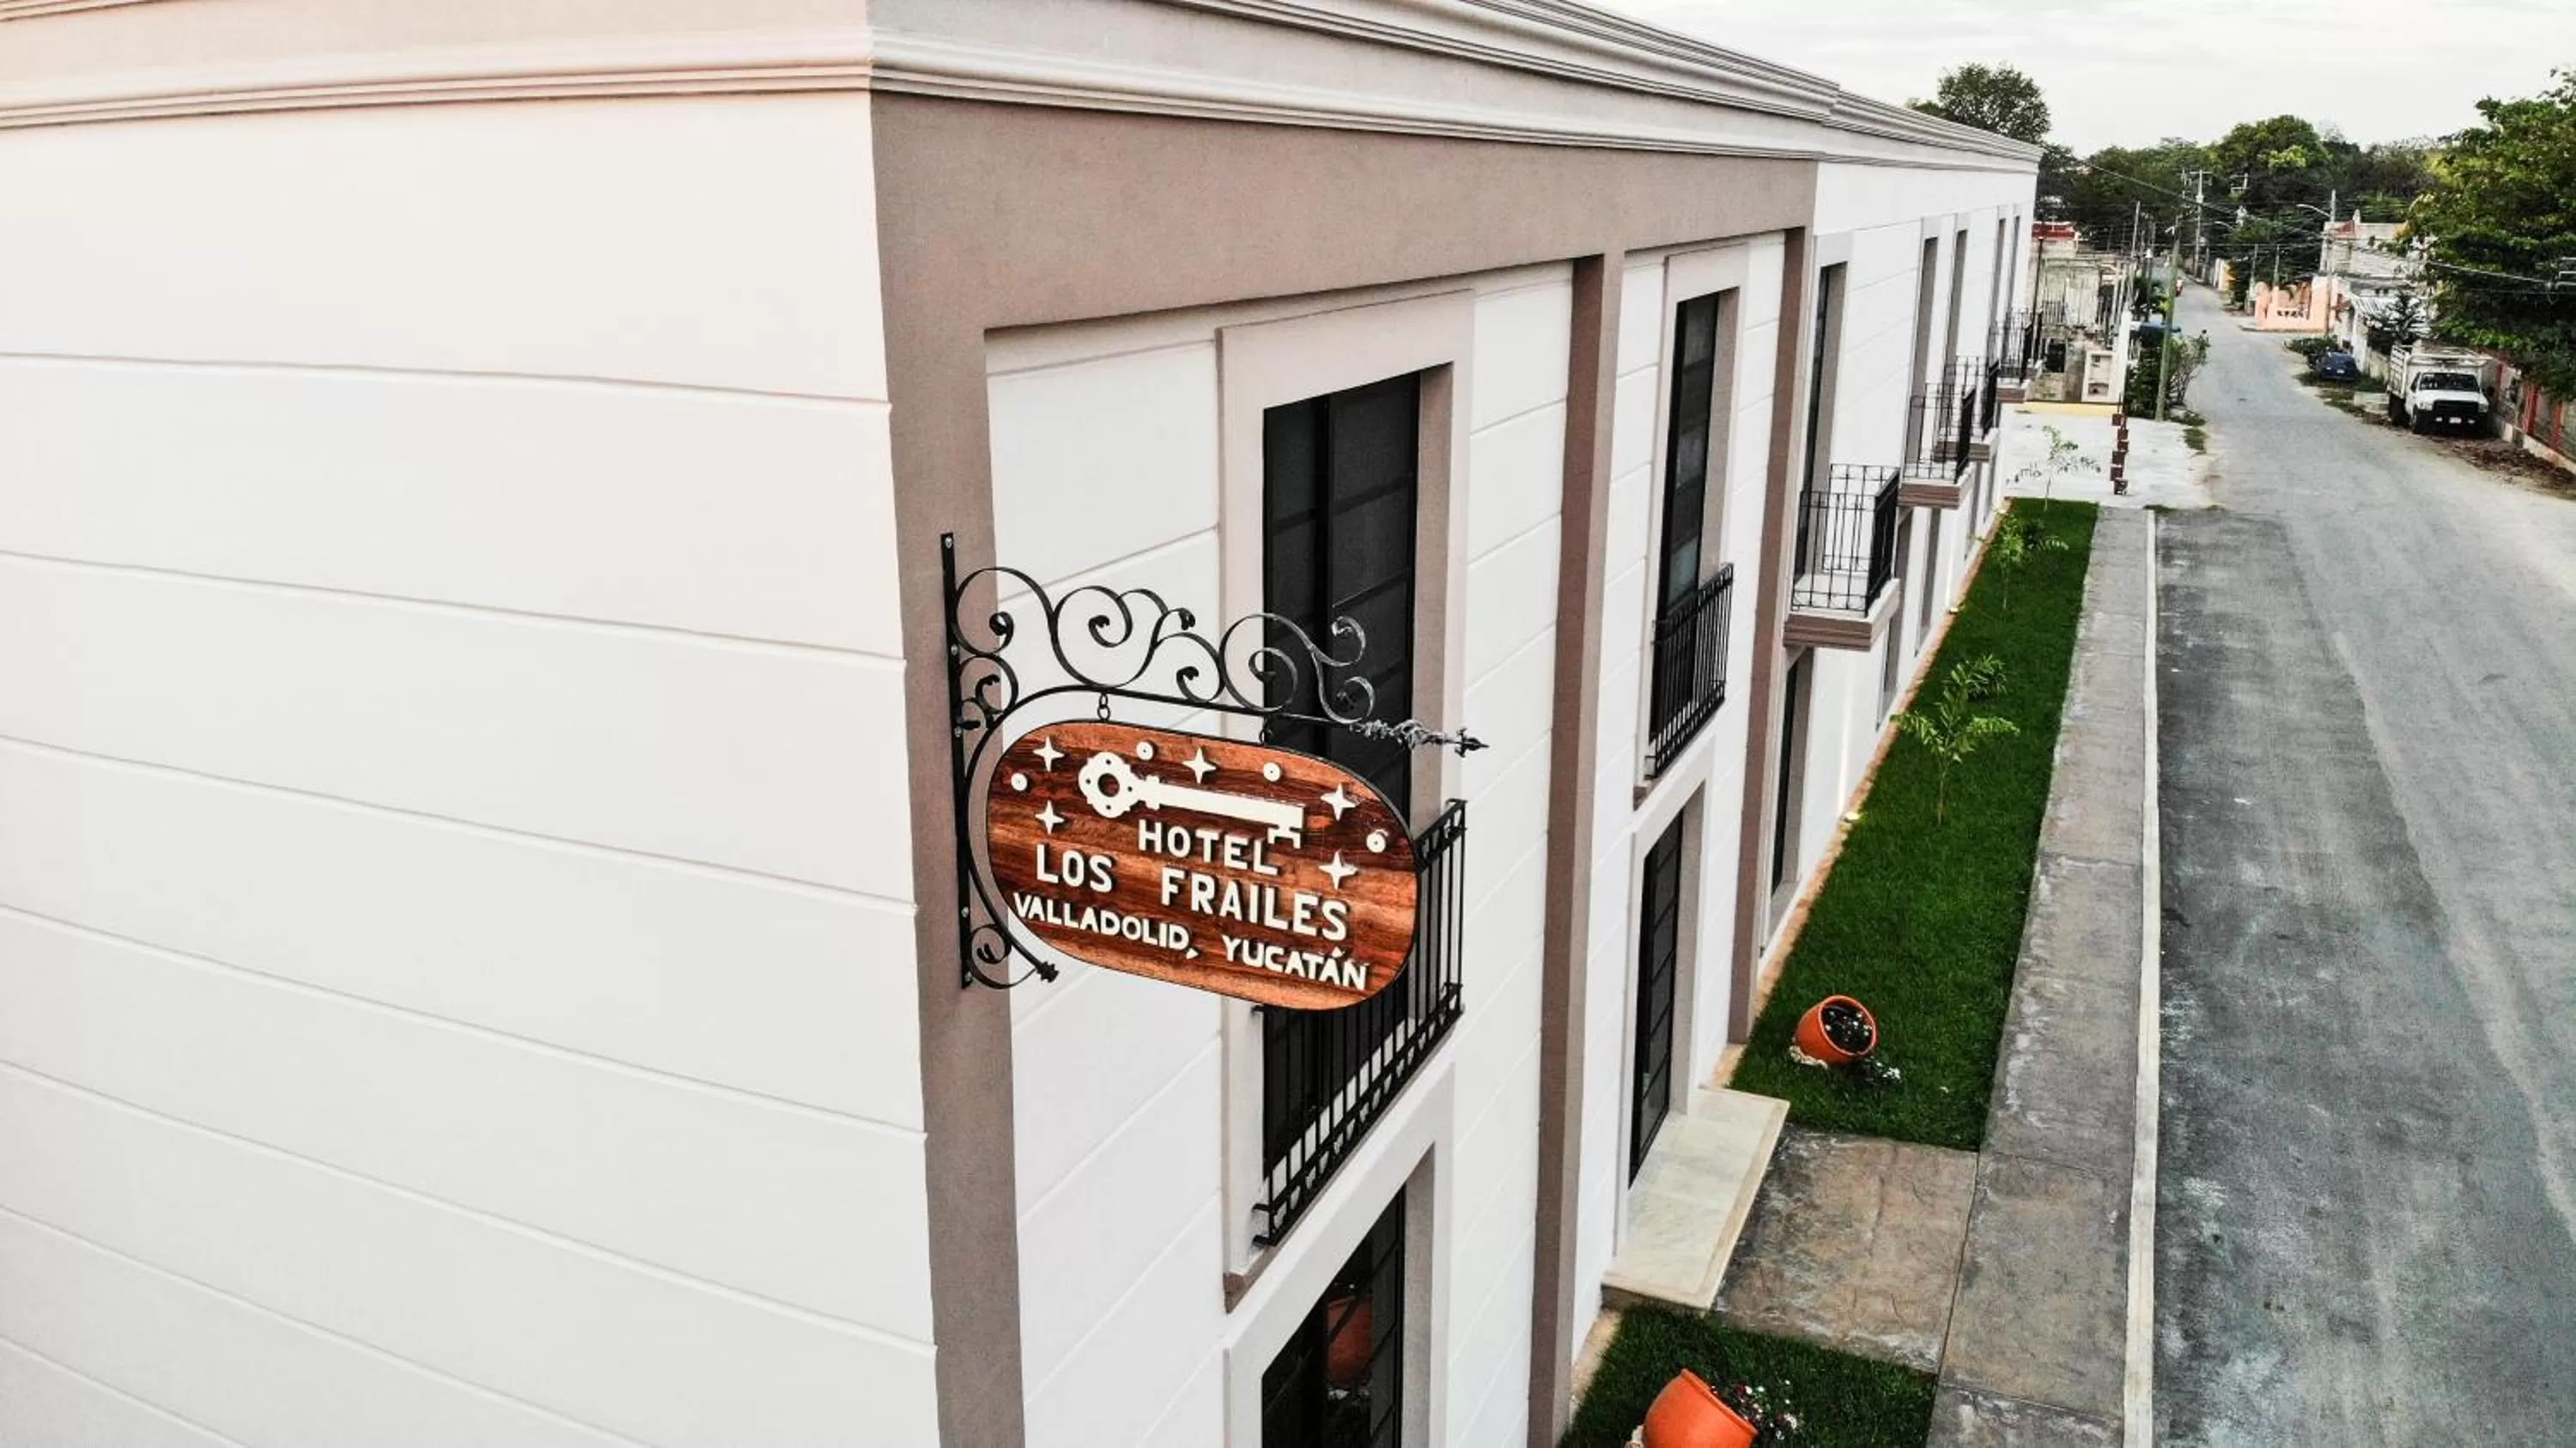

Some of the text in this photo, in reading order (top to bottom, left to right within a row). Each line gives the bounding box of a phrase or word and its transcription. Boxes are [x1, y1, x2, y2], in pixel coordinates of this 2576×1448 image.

[1036, 843, 1348, 941] LOS FRAILES
[1138, 818, 1279, 876] HOTEL
[1013, 891, 1370, 990] VALLADOLID, YUCATÁN
